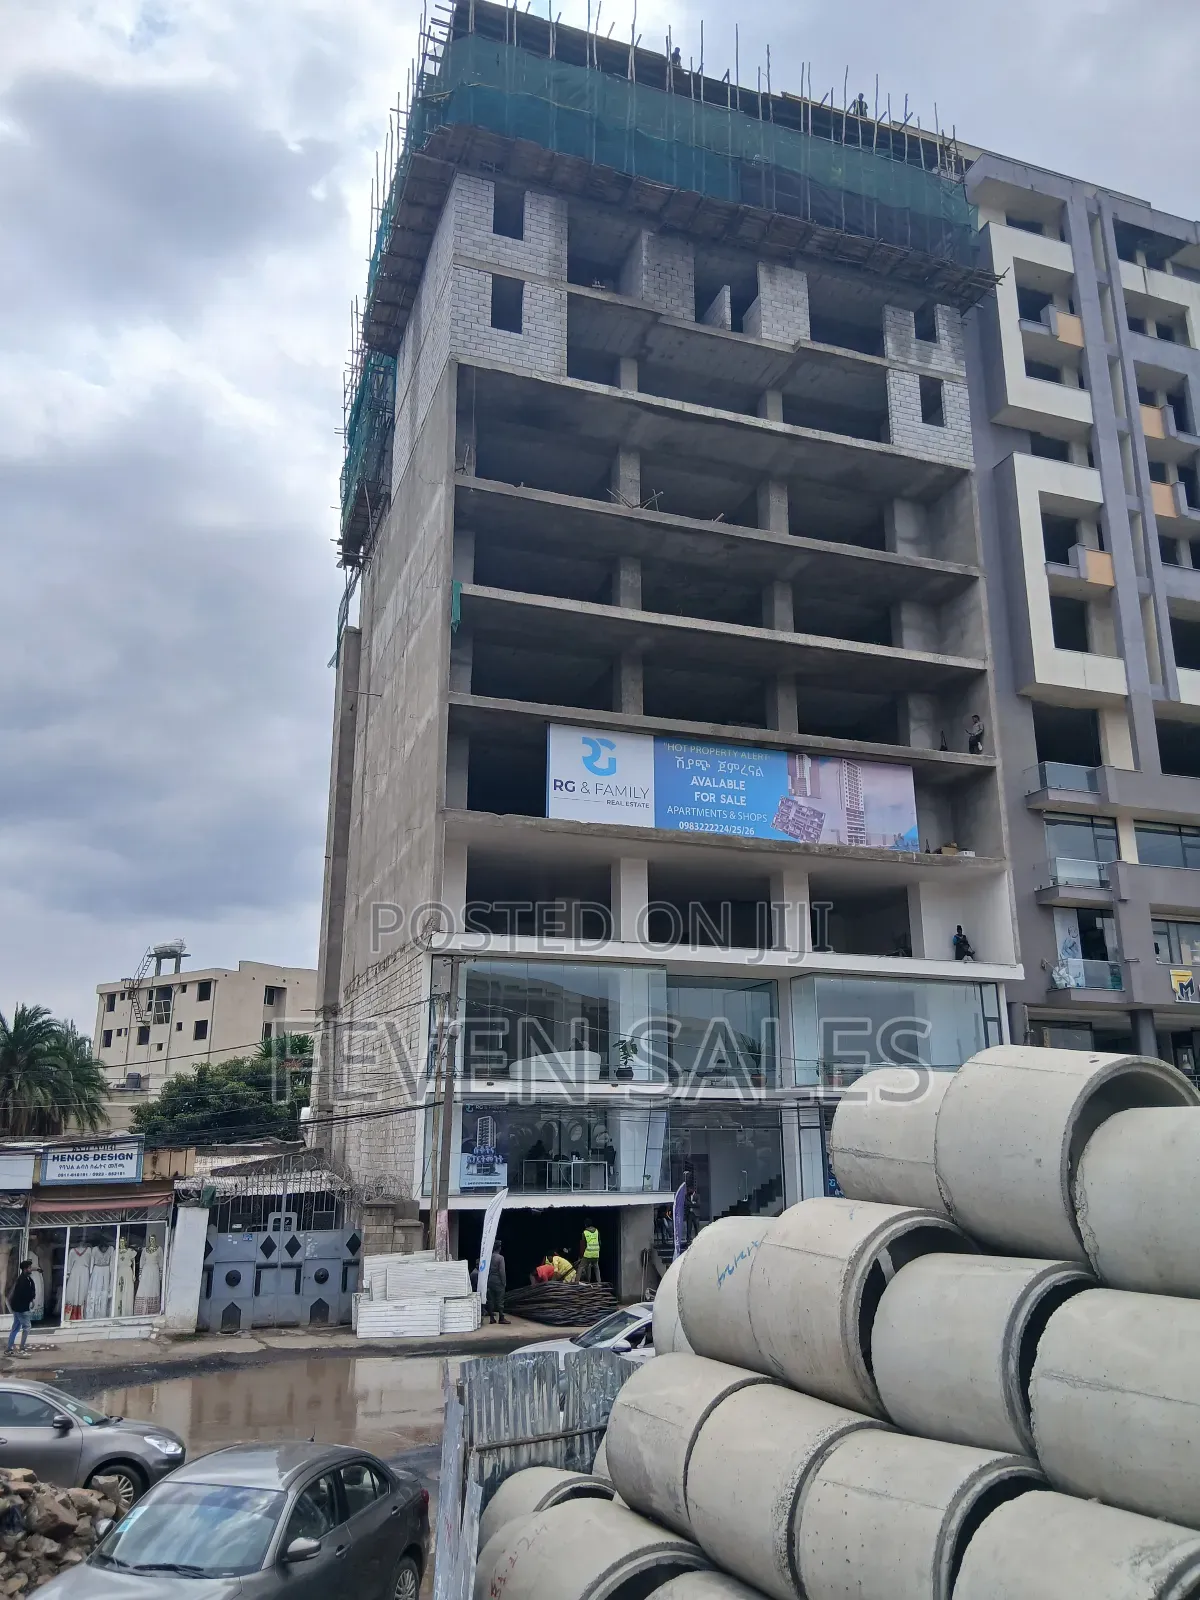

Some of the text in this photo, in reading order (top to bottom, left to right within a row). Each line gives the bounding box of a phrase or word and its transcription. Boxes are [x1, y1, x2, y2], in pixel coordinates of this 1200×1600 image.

[690, 745, 738, 757] PROPERTY
[675, 756, 764, 778] ሽያጭ ጀምረናል
[553, 778, 650, 800] RG & FAMILY
[690, 776, 746, 790] AVALABLE
[606, 799, 650, 809] REAL ESTATE
[694, 791, 747, 806] FOR SALE
[666, 805, 768, 823] APARTMENTS & SHOPS
[679, 821, 755, 835] 0983222224/25/26
[52, 1152, 134, 1162] HENOS DESIGN
